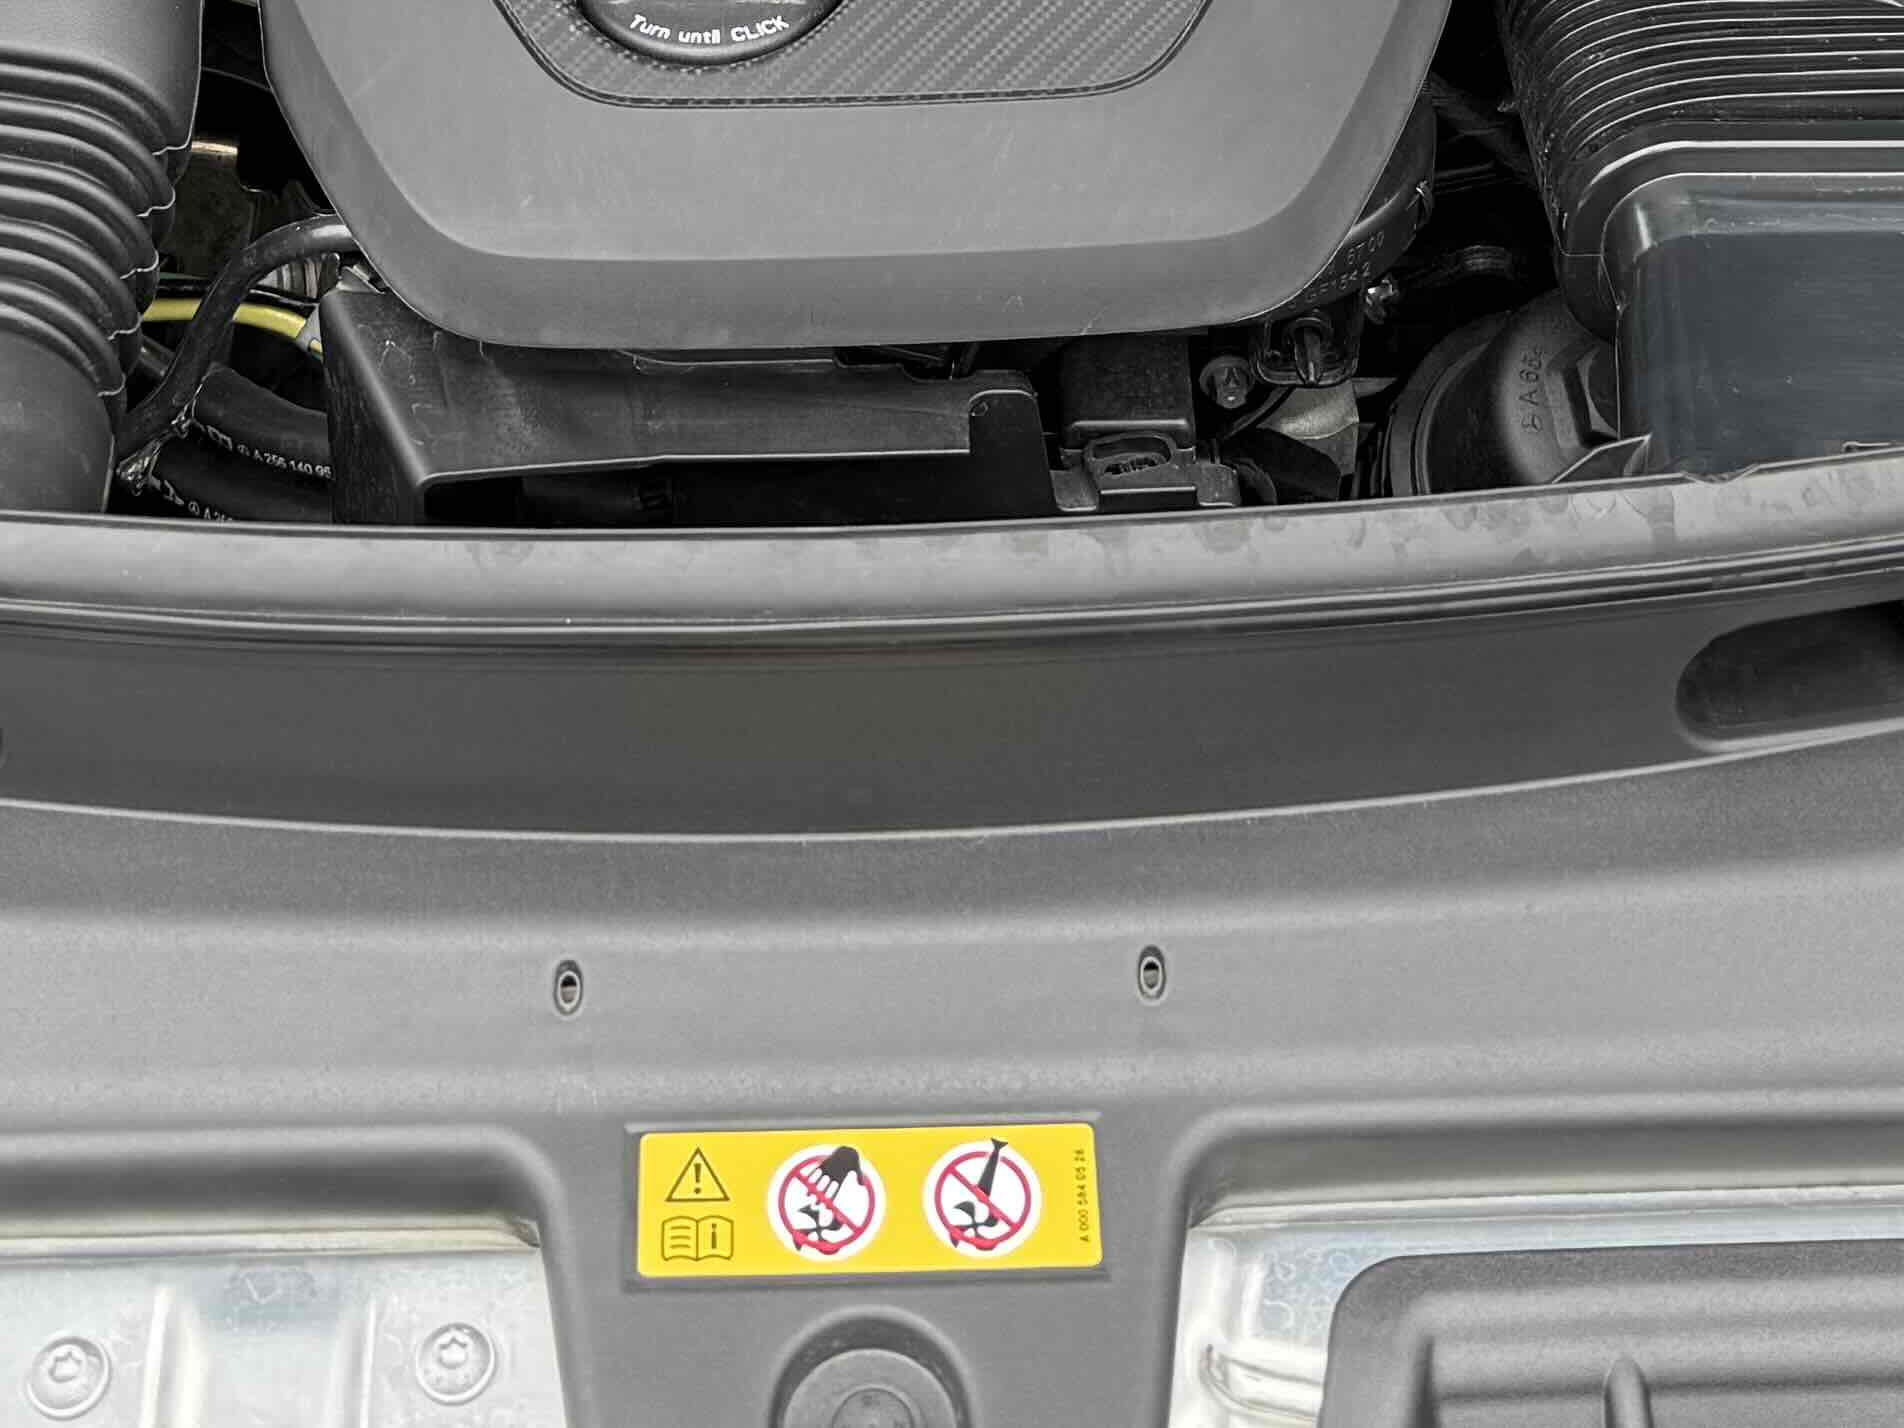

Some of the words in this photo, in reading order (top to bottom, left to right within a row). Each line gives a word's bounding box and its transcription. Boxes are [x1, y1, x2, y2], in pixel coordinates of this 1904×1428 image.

[629, 13, 672, 41] Turn
[677, 25, 722, 45] until
[731, 15, 790, 43] CLICK
[252, 448, 265, 463] A
[264, 452, 288, 470] 256
[289, 459, 314, 476] 140
[1078, 1209, 1089, 1232] 000
[1079, 1234, 1091, 1243] A
